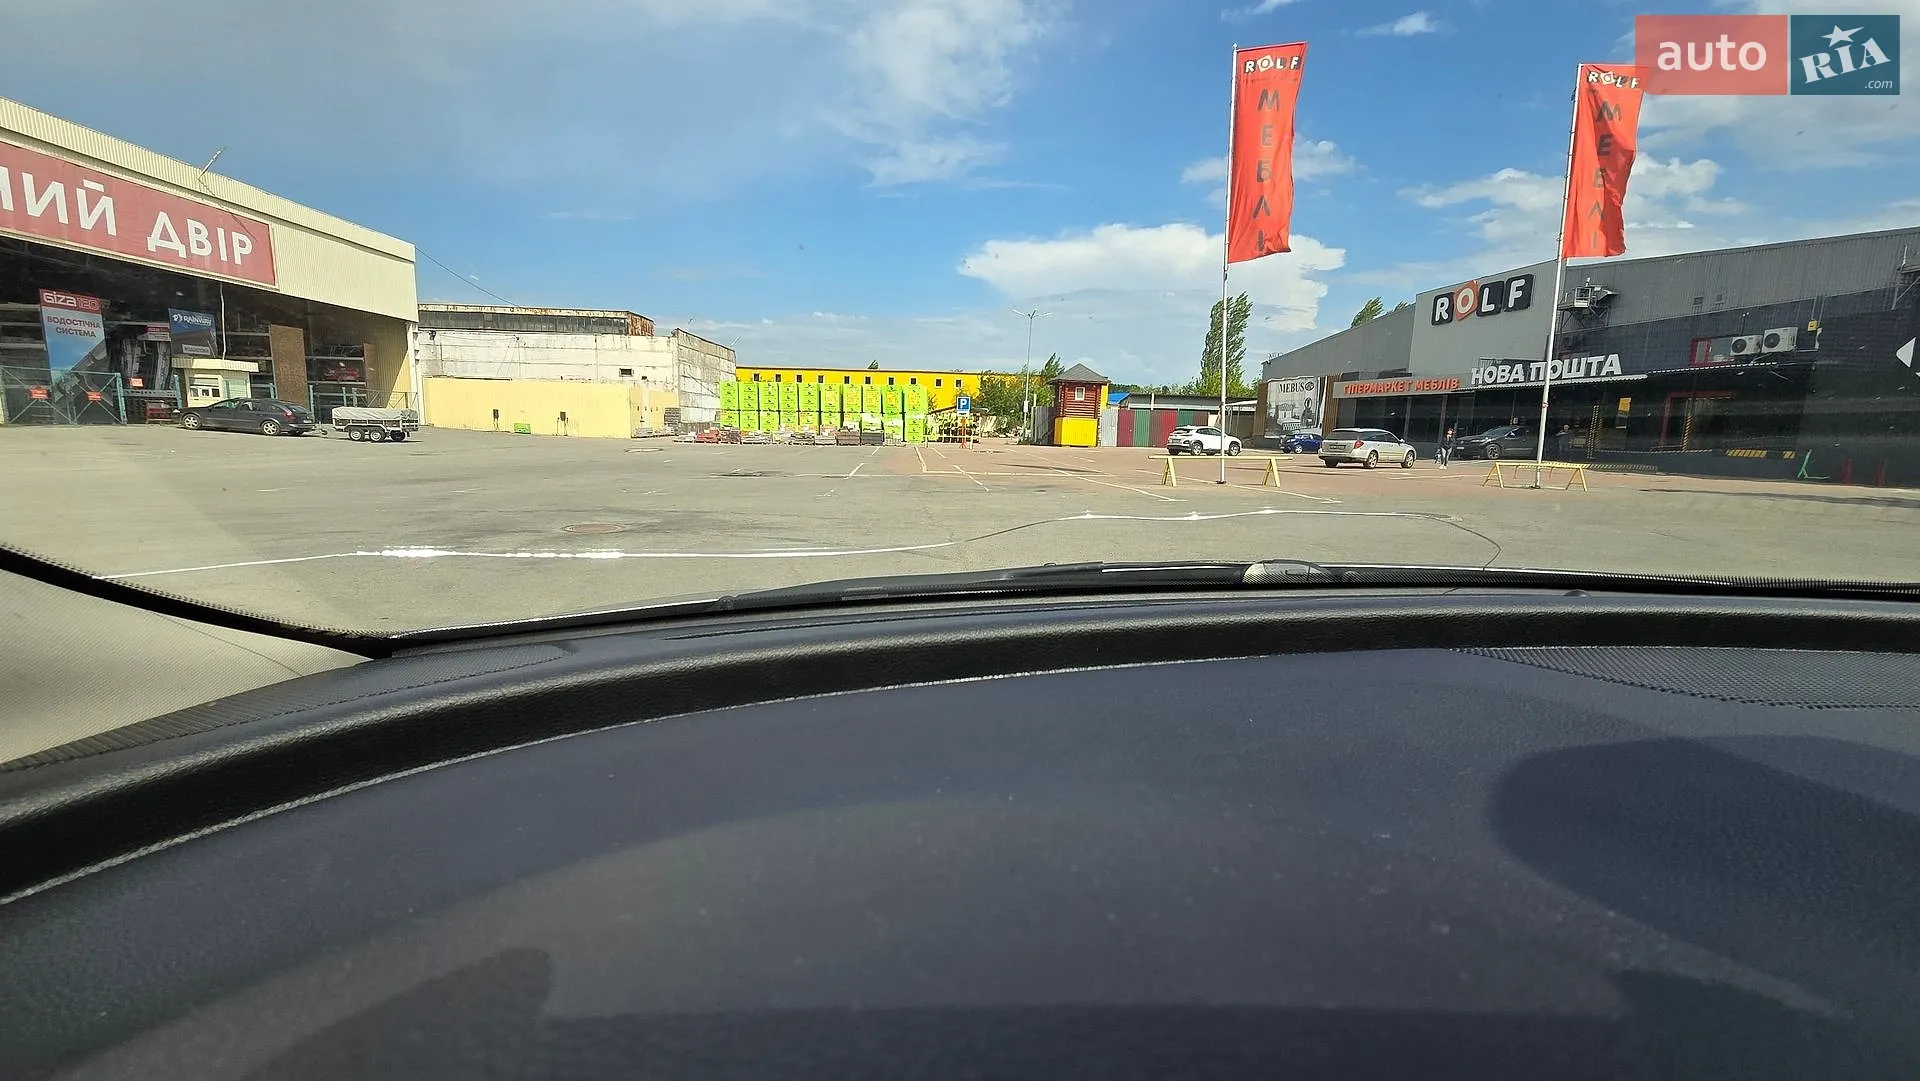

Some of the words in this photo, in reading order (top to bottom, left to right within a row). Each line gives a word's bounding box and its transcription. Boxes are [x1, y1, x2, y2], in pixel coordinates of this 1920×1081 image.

[1245, 55, 1300, 73] ROLF
[1587, 71, 1640, 88] ROLF
[147, 211, 253, 265] ДВІР
[1434, 278, 1526, 322] ROLF
[47, 315, 101, 329] ВОДОСТІЧНА
[55, 326, 97, 338] СИСТЕМА
[1471, 363, 1525, 385] НОВА
[1529, 353, 1622, 382] ПОШТА
[1415, 377, 1460, 392] МЕБЛІВ
